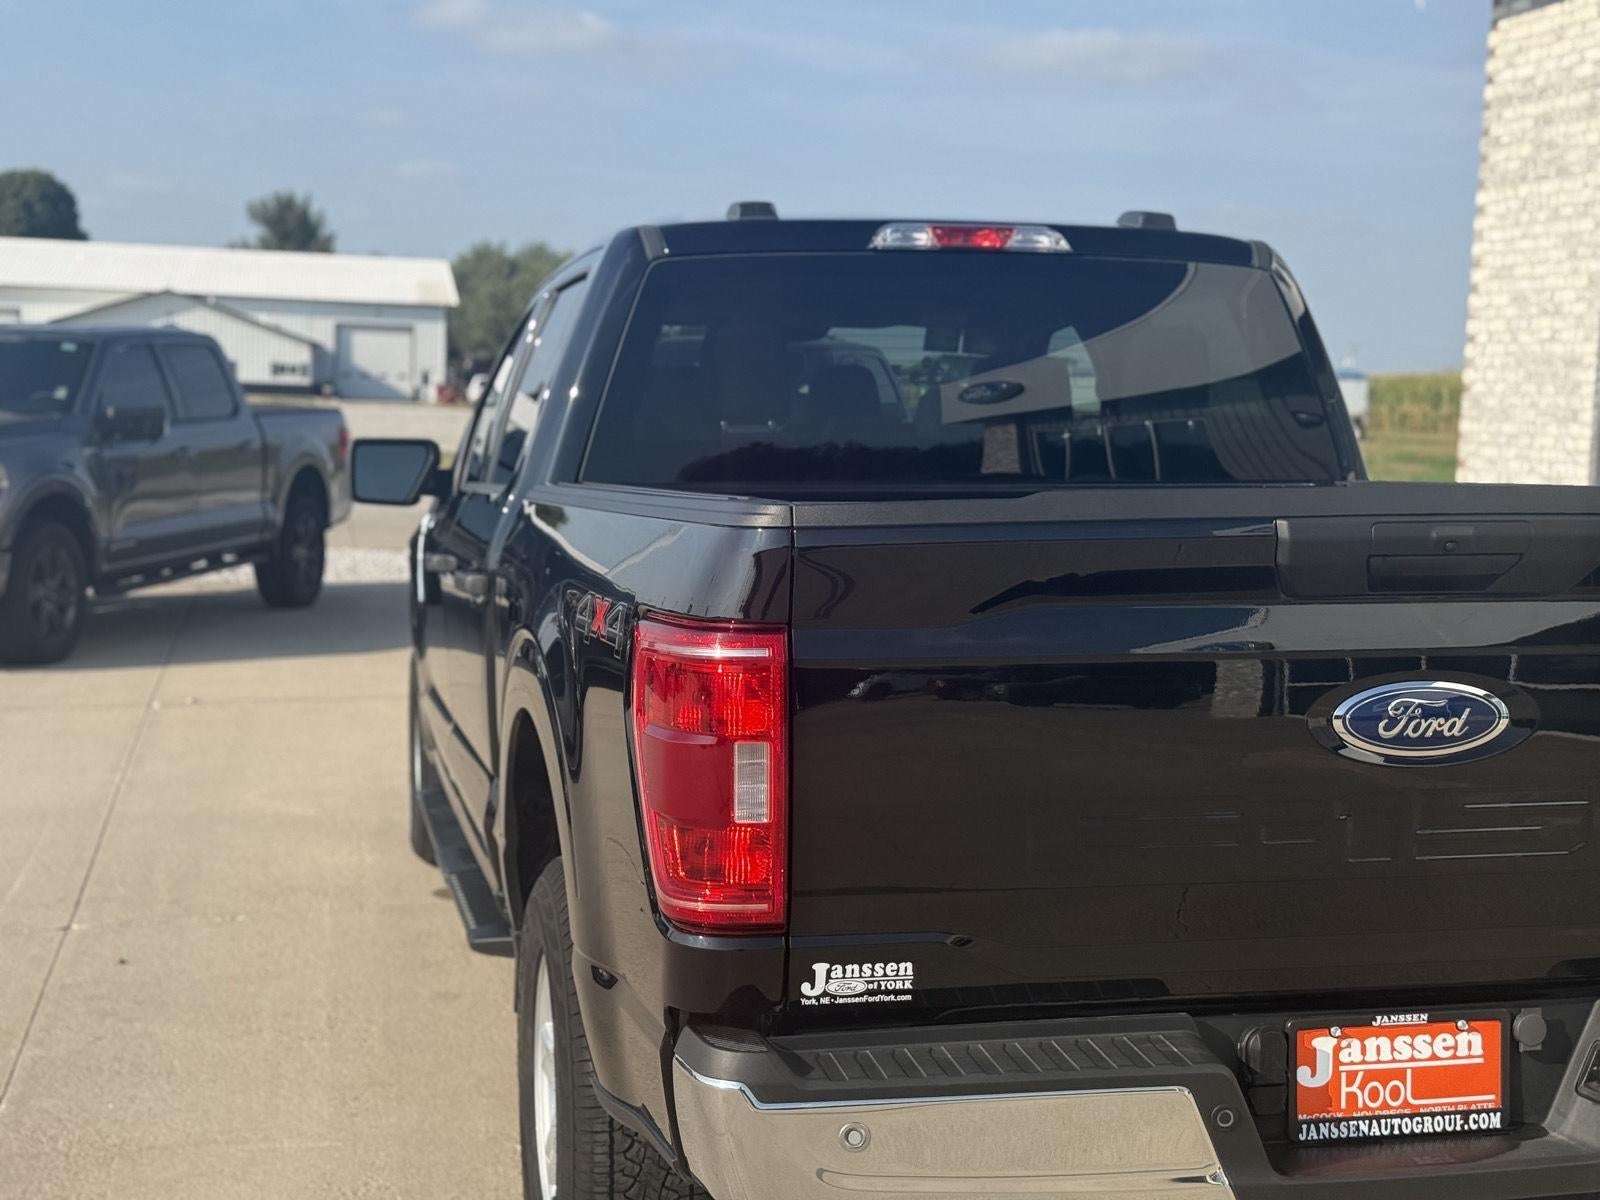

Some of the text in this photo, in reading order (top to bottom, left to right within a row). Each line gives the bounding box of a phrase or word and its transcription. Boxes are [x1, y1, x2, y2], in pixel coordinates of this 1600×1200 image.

[1377, 698, 1472, 739] Ford
[800, 961, 914, 996] Janssen
[868, 981, 878, 990] of
[880, 980, 913, 990] YORK
[800, 997, 818, 1006] York,
[1297, 1031, 1485, 1088] Janssen
[1340, 1068, 1496, 1110] Kool
